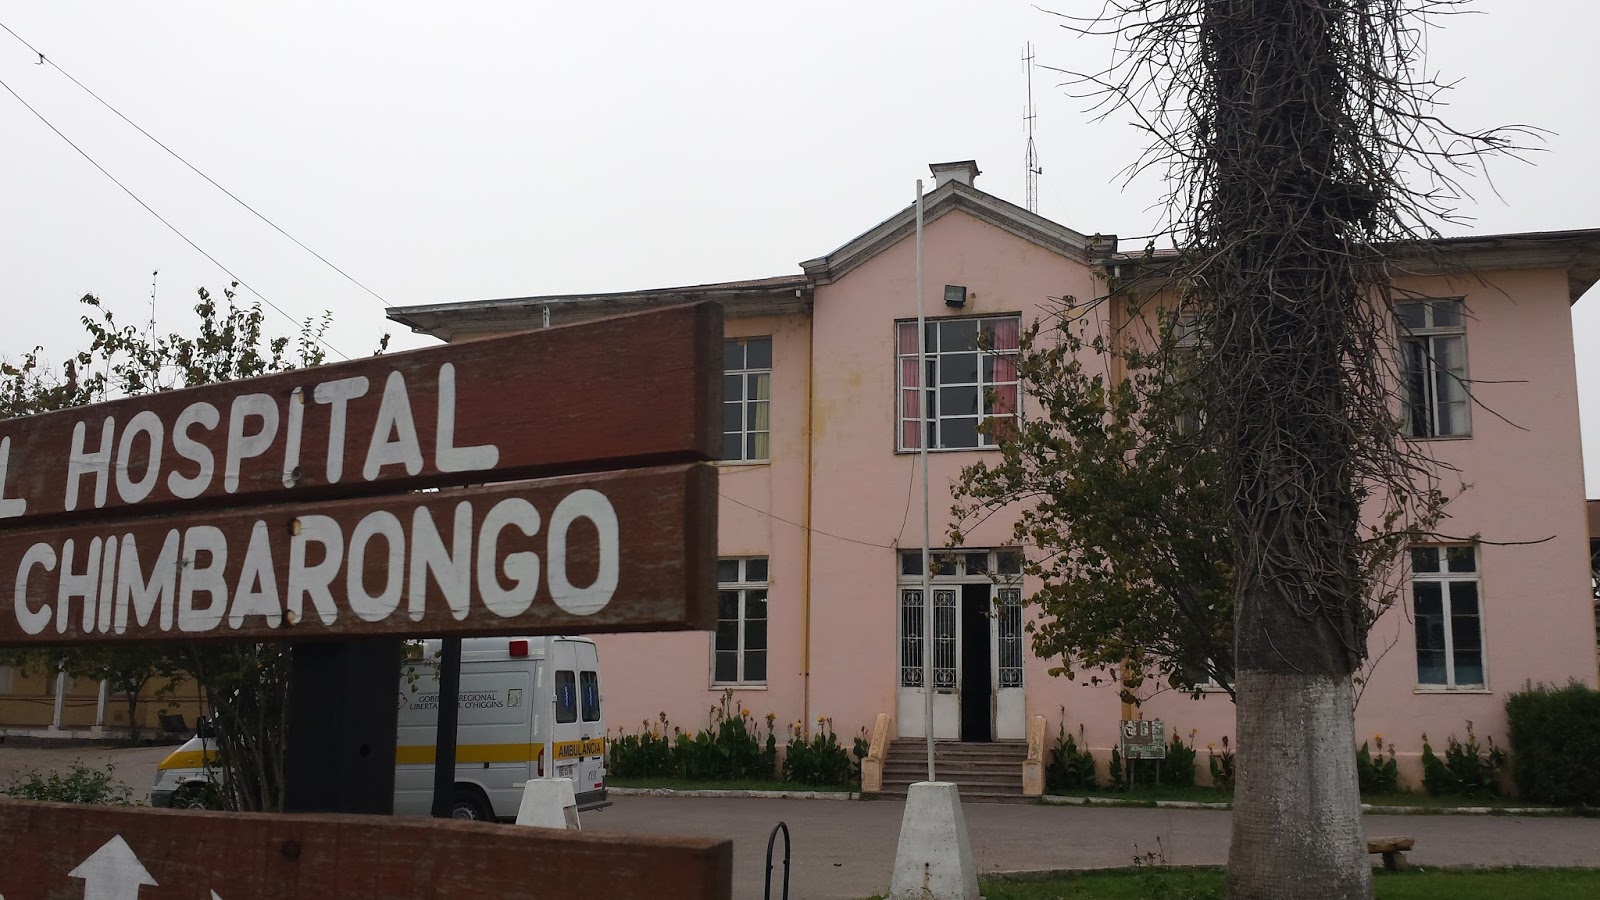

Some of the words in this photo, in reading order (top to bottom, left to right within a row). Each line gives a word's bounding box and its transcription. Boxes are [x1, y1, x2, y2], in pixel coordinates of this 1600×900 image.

[64, 362, 499, 512] HOSPITAL
[14, 488, 620, 636] CHIMBARONGO
[459, 694, 496, 702] REGIONAL
[465, 701, 504, 709] O'HIGGINS
[558, 742, 601, 757] AMBULANCIA
